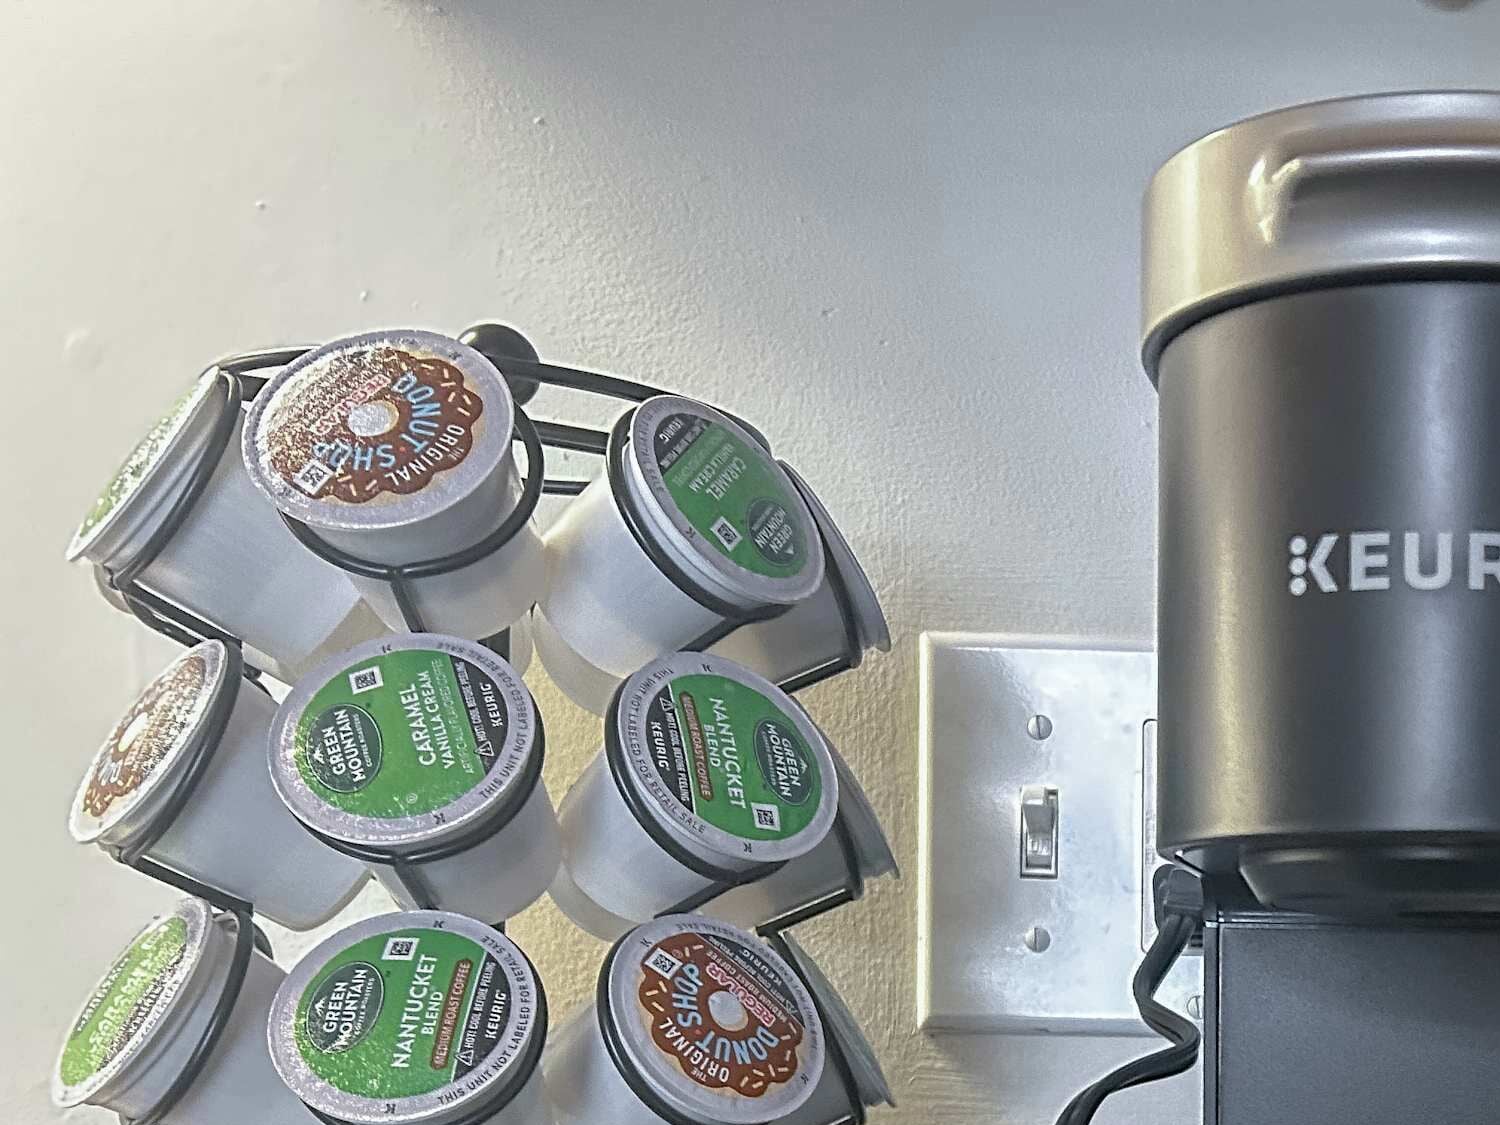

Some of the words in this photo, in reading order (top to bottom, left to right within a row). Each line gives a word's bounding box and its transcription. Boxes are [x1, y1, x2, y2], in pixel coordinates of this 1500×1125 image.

[391, 371, 443, 454] DONUT
[384, 424, 465, 487] ORIGINAL
[705, 456, 747, 501] CARAMEL
[689, 466, 716, 494] CREAM
[754, 507, 787, 549] MOUNTAIN
[769, 523, 794, 554] GREEN
[418, 669, 440, 713] CREAM
[480, 682, 504, 728] KEURIG
[334, 708, 366, 783] MOUNTAIN
[400, 683, 437, 767] CARAMEL
[431, 713, 456, 769] VANILLA
[650, 721, 670, 769] KEURIG
[703, 723, 721, 768] BLEND
[321, 726, 347, 776] GREEN
[480, 777, 504, 799] THIS
[499, 754, 520, 778] UNIT
[513, 732, 528, 753] NOT
[709, 697, 747, 809] NANTUCKET
[764, 723, 793, 798] MOUNTAIN
[781, 737, 802, 788] GREEN
[679, 813, 706, 834] SALE
[481, 935, 506, 954] SALE
[706, 950, 737, 975] COFFEE
[504, 953, 526, 983] RETAIL
[736, 973, 761, 998] ROAST
[742, 949, 782, 987] KEURIG
[322, 982, 348, 1033] GREEN
[338, 968, 368, 1047] MOUNTAIN
[391, 954, 437, 1068] NANTUCKET
[421, 990, 443, 1036] BLEND
[443, 995, 460, 1024] ROAST
[453, 962, 471, 996] COFFEE
[485, 989, 507, 1039] KEURIG
[518, 983, 530, 1003] FOR
[672, 963, 703, 1028] SHOP
[705, 962, 777, 1028] REGULAR
[465, 1030, 478, 1049] HOT!
[508, 1006, 530, 1051] LABELED
[658, 1016, 731, 1084] ORIGINAL
[696, 1026, 780, 1065] DONUT
[466, 1070, 493, 1091] UNIT
[492, 1050, 511, 1072] NOT
[690, 1066, 708, 1083] THE
[437, 1087, 466, 1105] THIS
